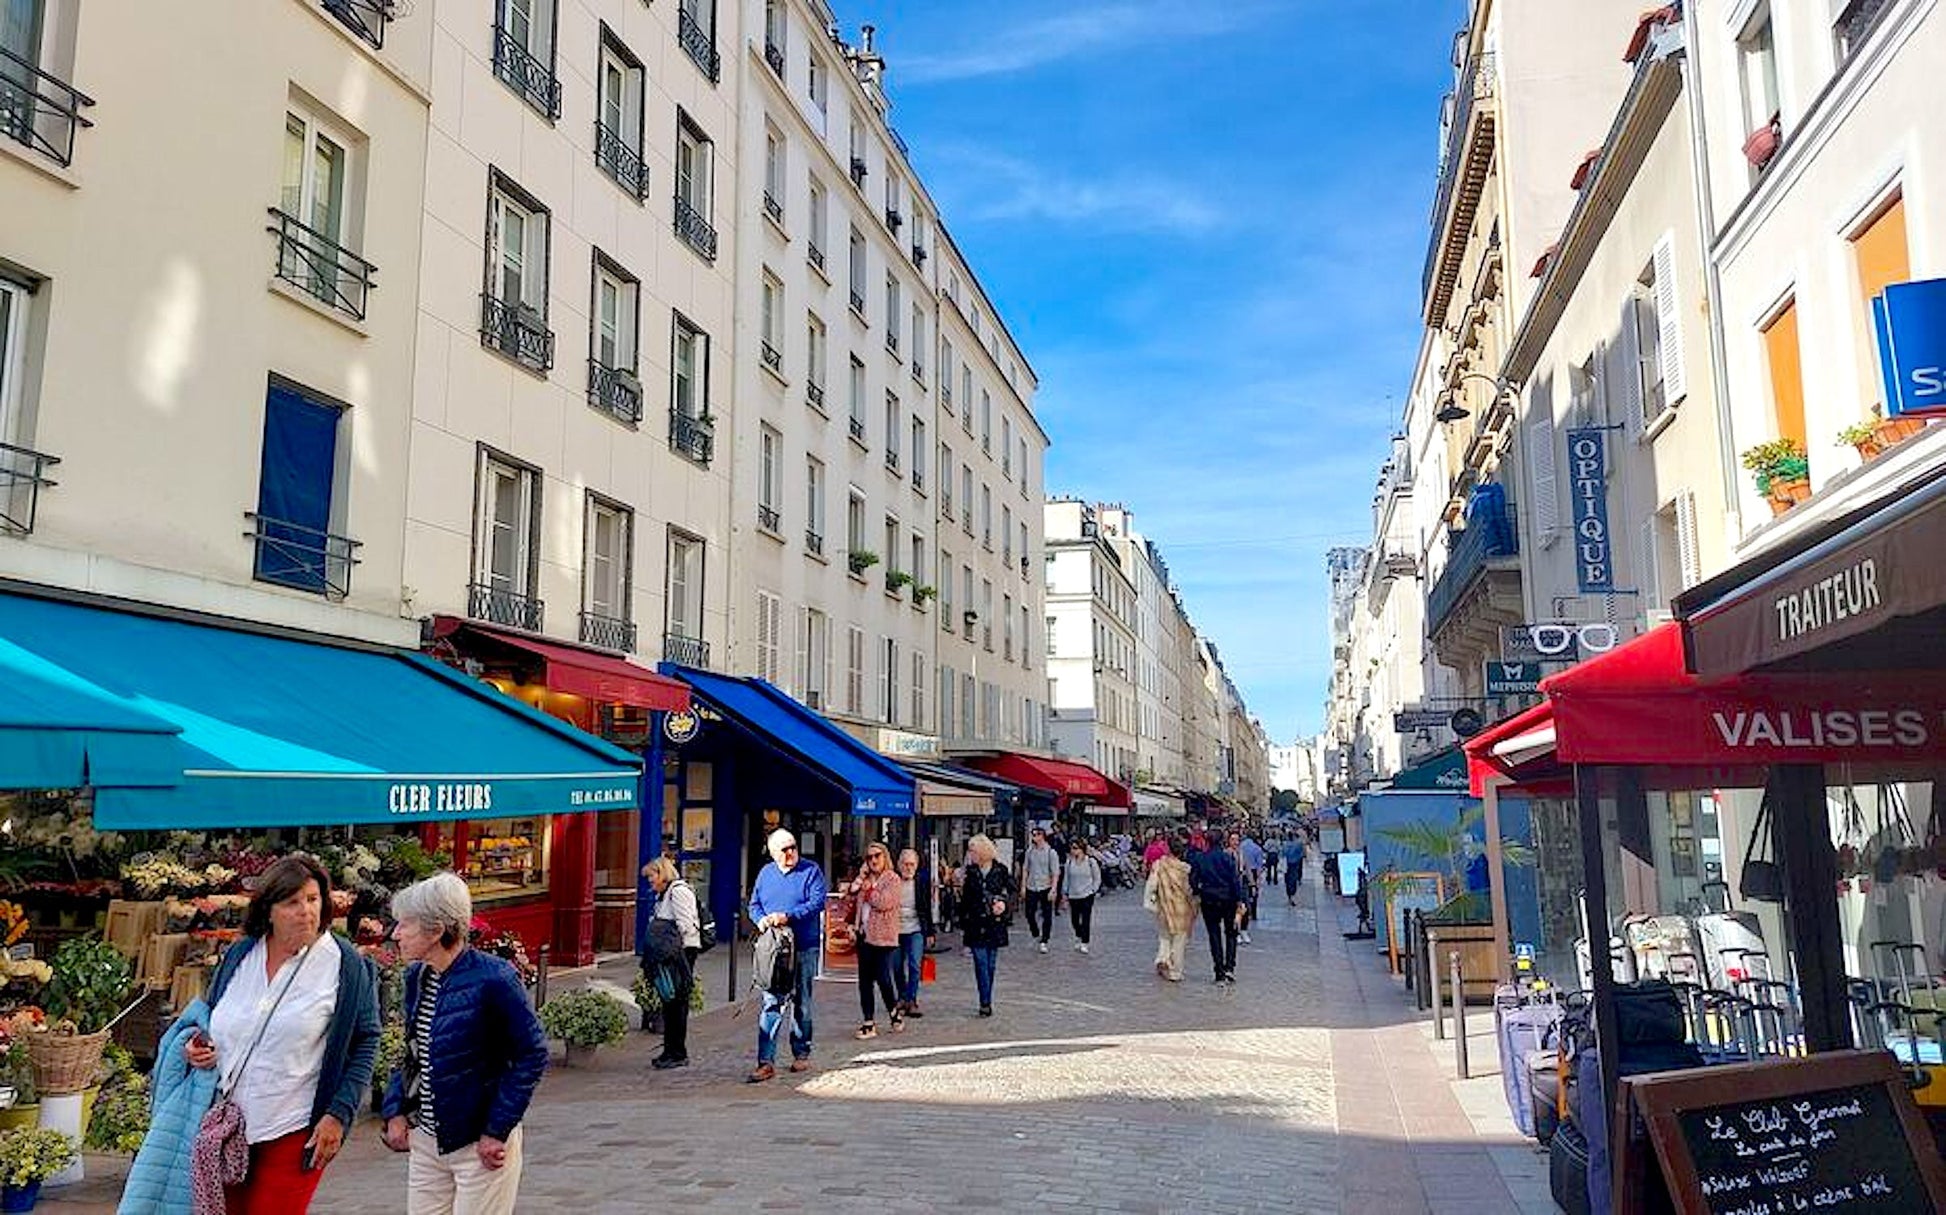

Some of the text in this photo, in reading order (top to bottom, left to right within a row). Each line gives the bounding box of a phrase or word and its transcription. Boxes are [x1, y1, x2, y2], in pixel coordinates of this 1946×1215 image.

[1911, 366, 1946, 397] S
[1573, 439, 1607, 584] OPTIQUE
[1775, 558, 1880, 641] TRAITEUR
[1712, 709, 1928, 747] VALISES
[389, 783, 492, 813] CLER FLEURS
[1705, 1115, 1738, 1140] Le
[1741, 1106, 1790, 1133] Club
